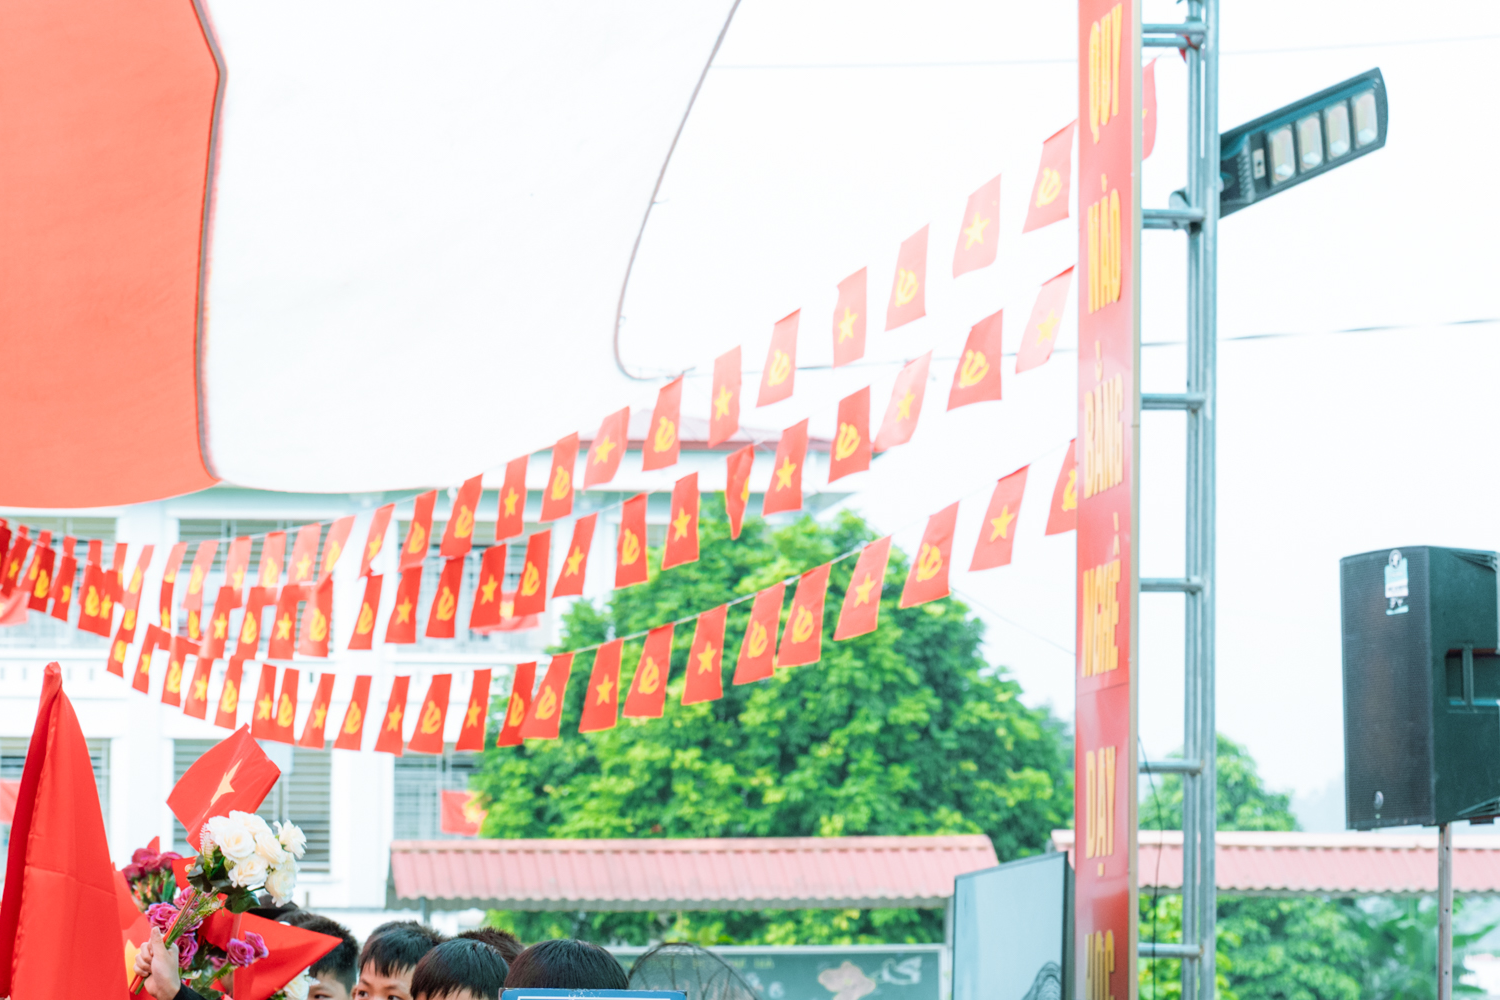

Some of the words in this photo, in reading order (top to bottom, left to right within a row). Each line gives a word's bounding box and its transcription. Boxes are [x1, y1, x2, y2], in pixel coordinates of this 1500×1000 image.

[1088, 173, 1121, 314] NÀO
[1084, 340, 1124, 499] BẰNG
[1082, 512, 1120, 678] NGHỀ
[1086, 746, 1115, 876] DẠY
